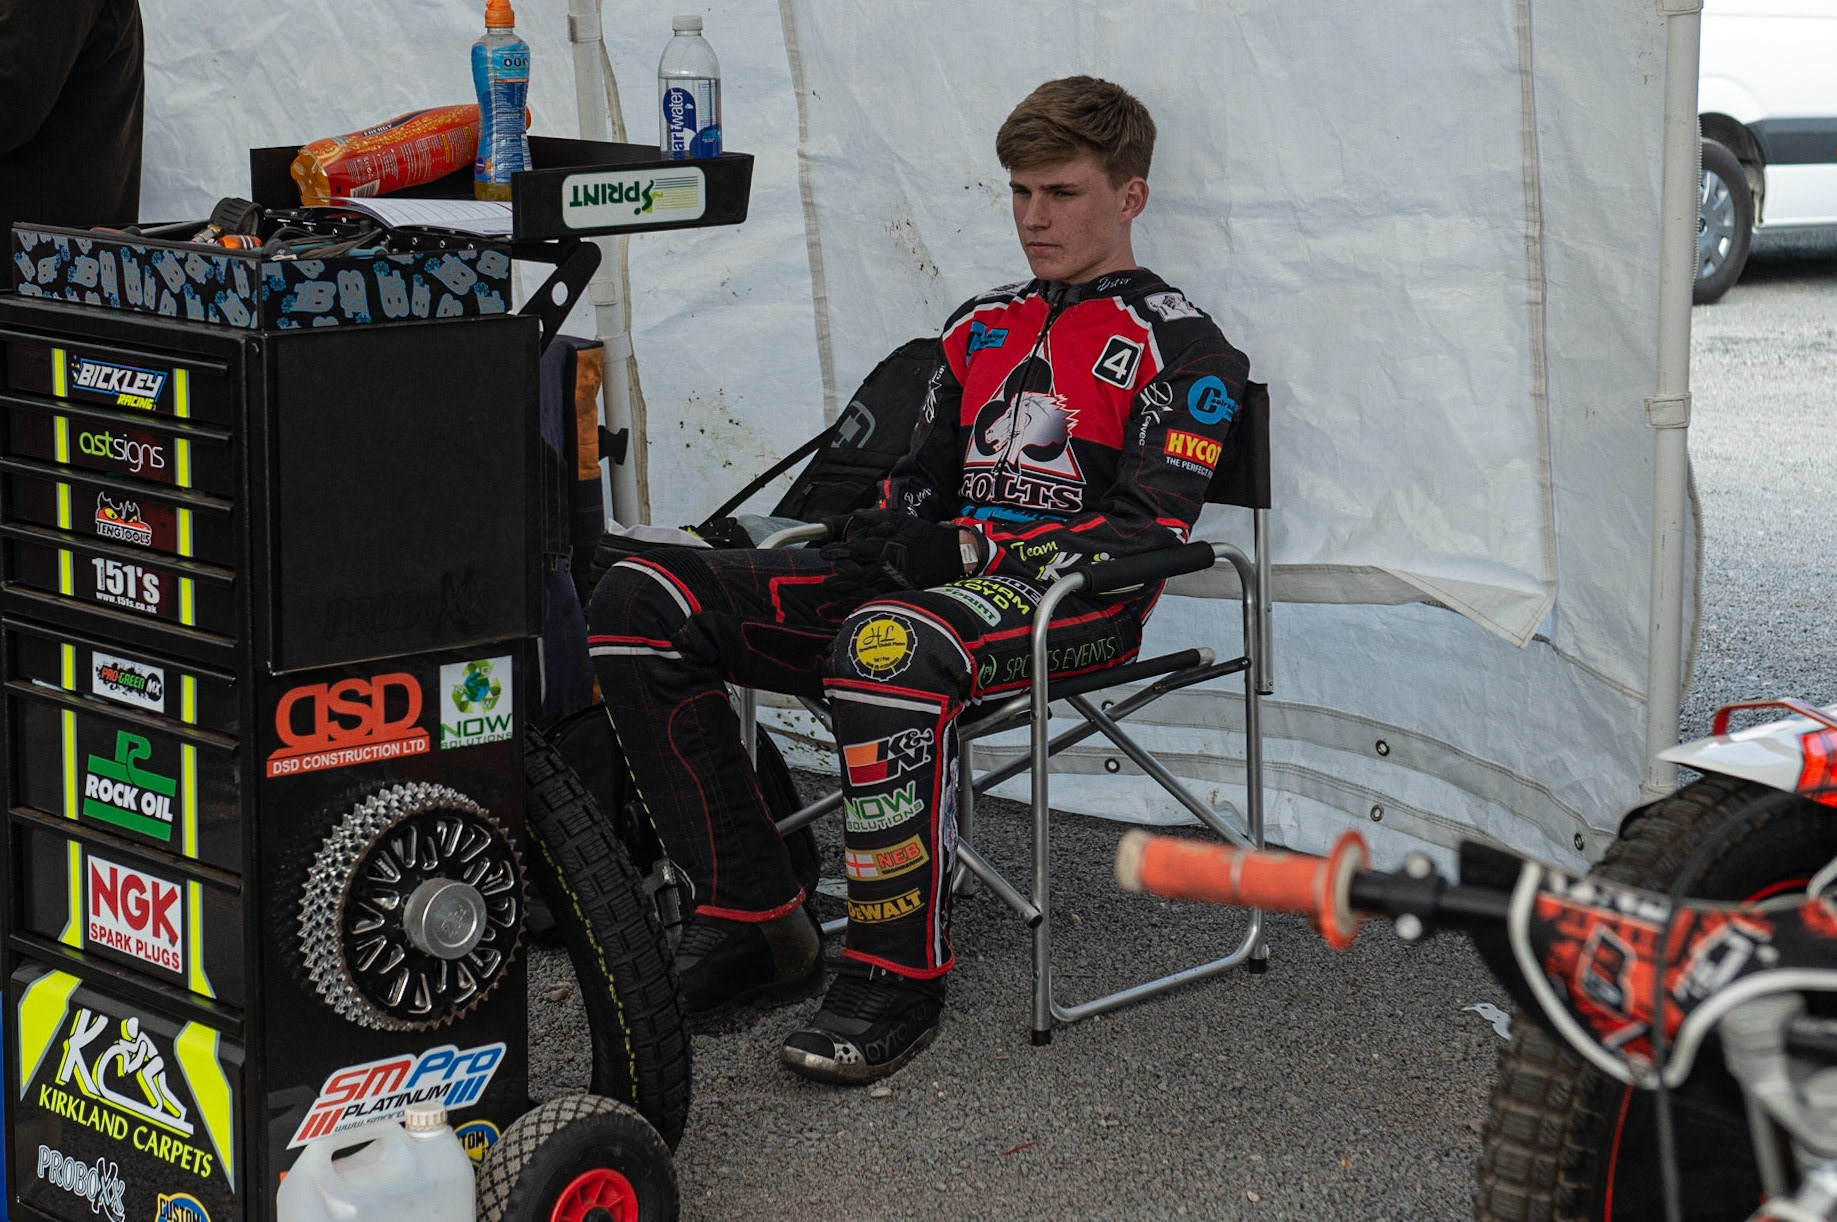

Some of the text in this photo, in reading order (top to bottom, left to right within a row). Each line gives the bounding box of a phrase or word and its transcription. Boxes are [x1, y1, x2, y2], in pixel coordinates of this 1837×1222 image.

[669, 89, 685, 152] artwater
[569, 179, 655, 215] SPRINT
[1104, 347, 1133, 380] 4
[76, 362, 164, 400] BICKLEY
[117, 393, 155, 411] RACING
[1166, 456, 1181, 467] THE
[1181, 460, 1208, 477] PERFECT
[959, 472, 1083, 513] COLTS
[1010, 541, 1059, 562] Team
[96, 591, 157, 614] www.151s.co.uk
[1062, 636, 1116, 670] EVENTS
[146, 679, 162, 696] MX
[441, 713, 512, 741] NOW
[441, 732, 512, 750] SOLUTIONS
[273, 738, 426, 775] DSD CONSTRUCTION LTD
[85, 774, 173, 822] ROCK OIL
[844, 781, 916, 822] NOW
[847, 802, 923, 832] SOLUTIONS
[876, 842, 921, 869] NEB
[91, 860, 179, 947] NGK
[90, 921, 180, 971] SPARK PLUGS
[341, 1082, 452, 1120] PLATINUM
[39, 1083, 213, 1178] KIRKLAND CARPETS
[459, 1129, 486, 1151] TOM
